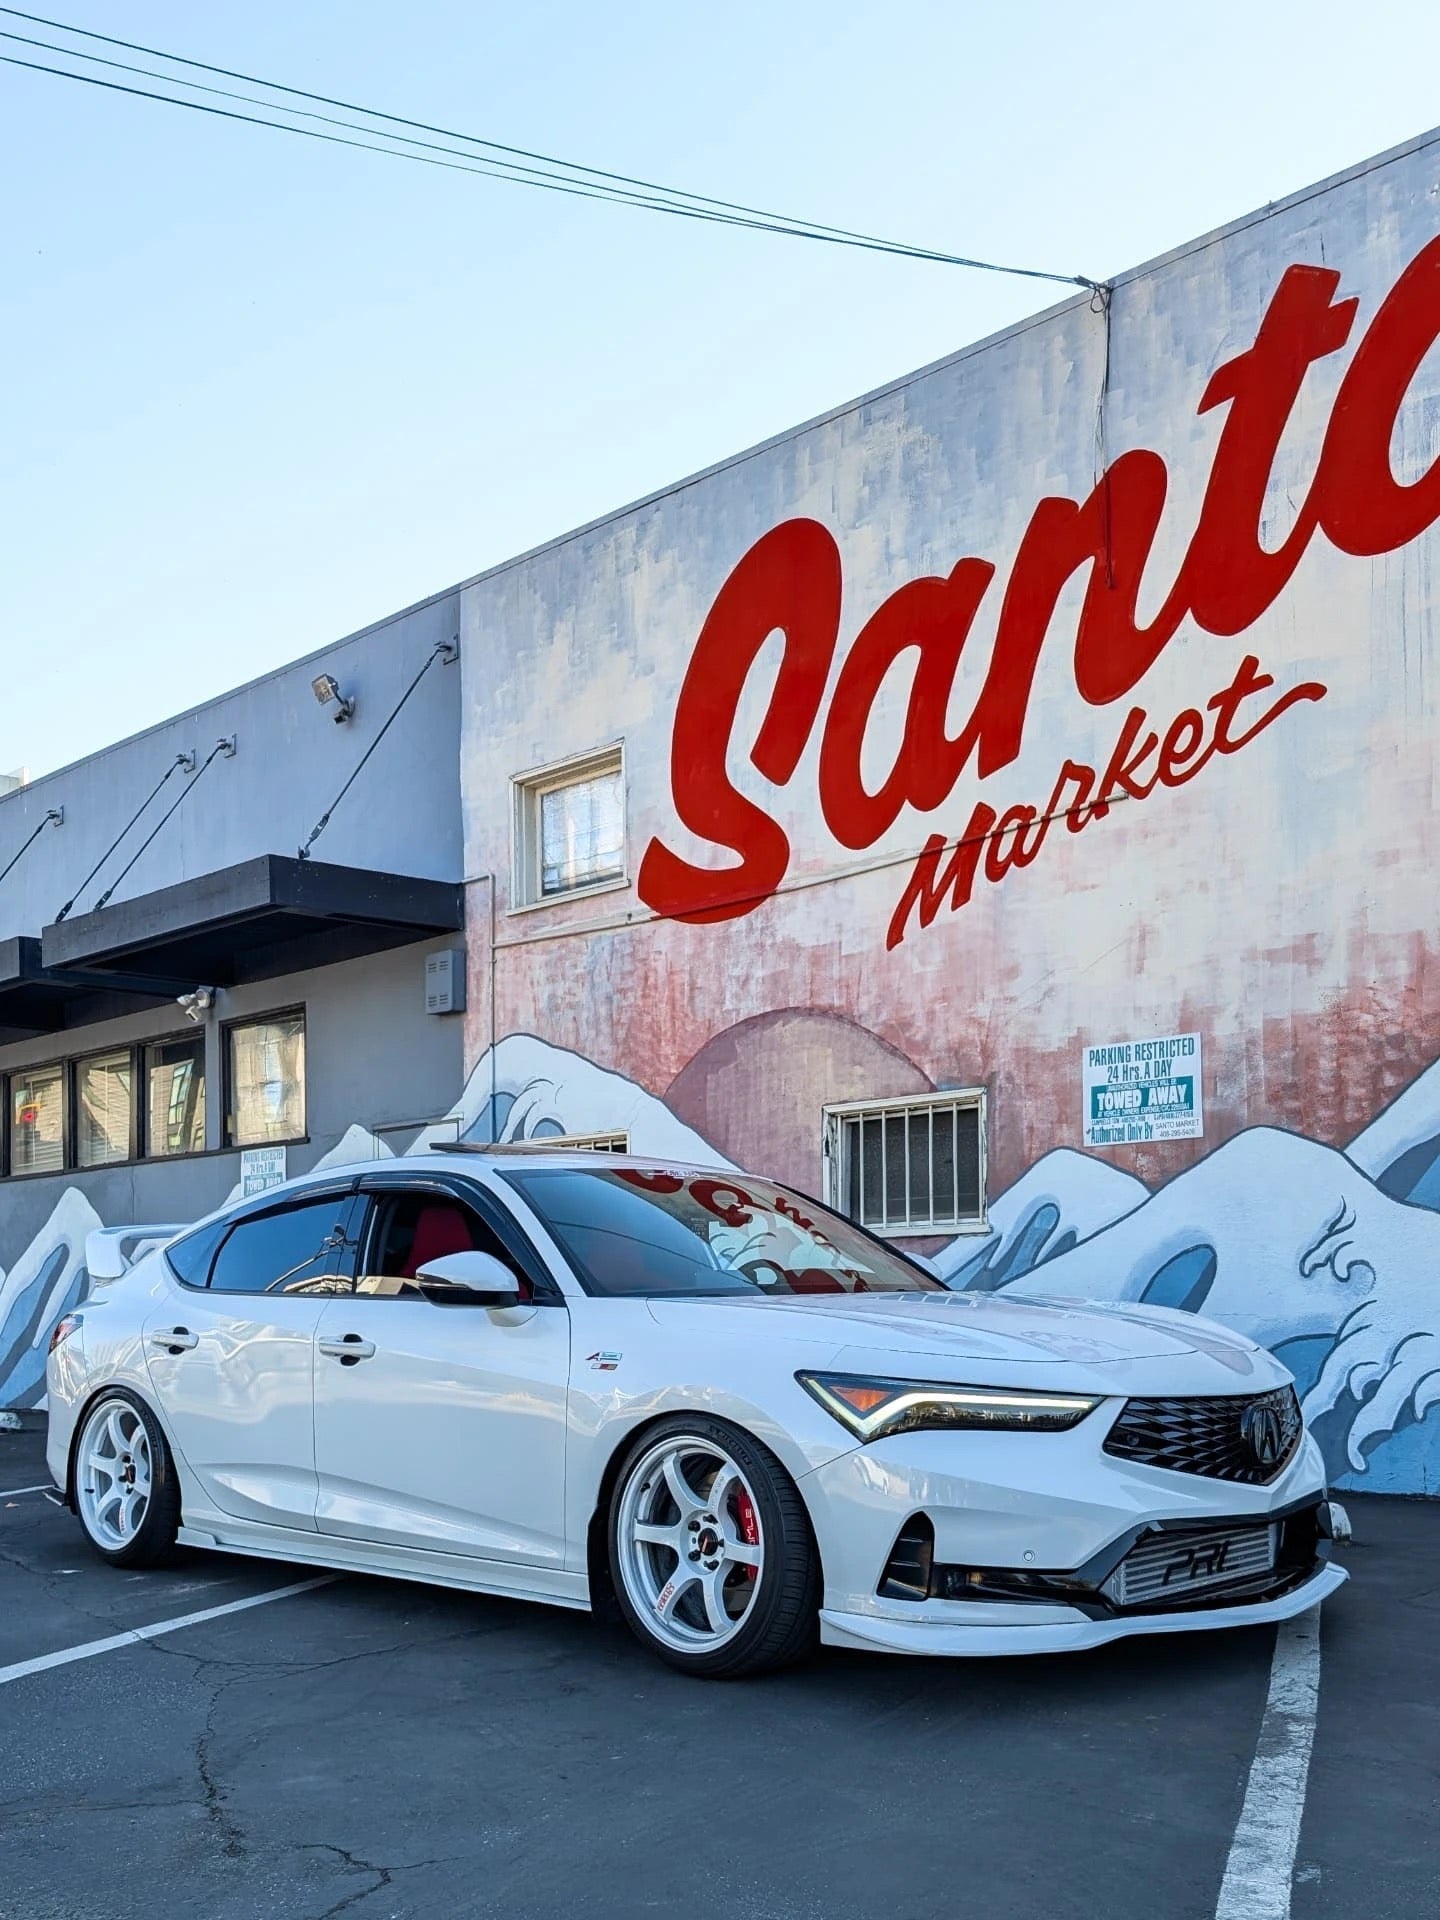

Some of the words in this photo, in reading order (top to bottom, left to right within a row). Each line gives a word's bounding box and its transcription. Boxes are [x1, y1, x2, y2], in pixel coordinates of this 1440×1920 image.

[886, 655, 1327, 952] Market
[1089, 1045, 1130, 1067] PARKING
[1134, 1036, 1194, 1062] RESTRICTED
[1107, 1065, 1118, 1083] 24
[1143, 1061, 1150, 1079] A
[1153, 1058, 1172, 1078] DAY
[1097, 1088, 1141, 1111] TOWED
[1147, 1084, 1187, 1106] AWAY
[1090, 1124, 1124, 1144] Authorized
[1128, 1122, 1143, 1140] Only
[1144, 1121, 1153, 1139] By
[1155, 1121, 1174, 1130] SANTO
[1175, 1118, 1199, 1128] MARKET
[1161, 1540, 1240, 1586] PRL
